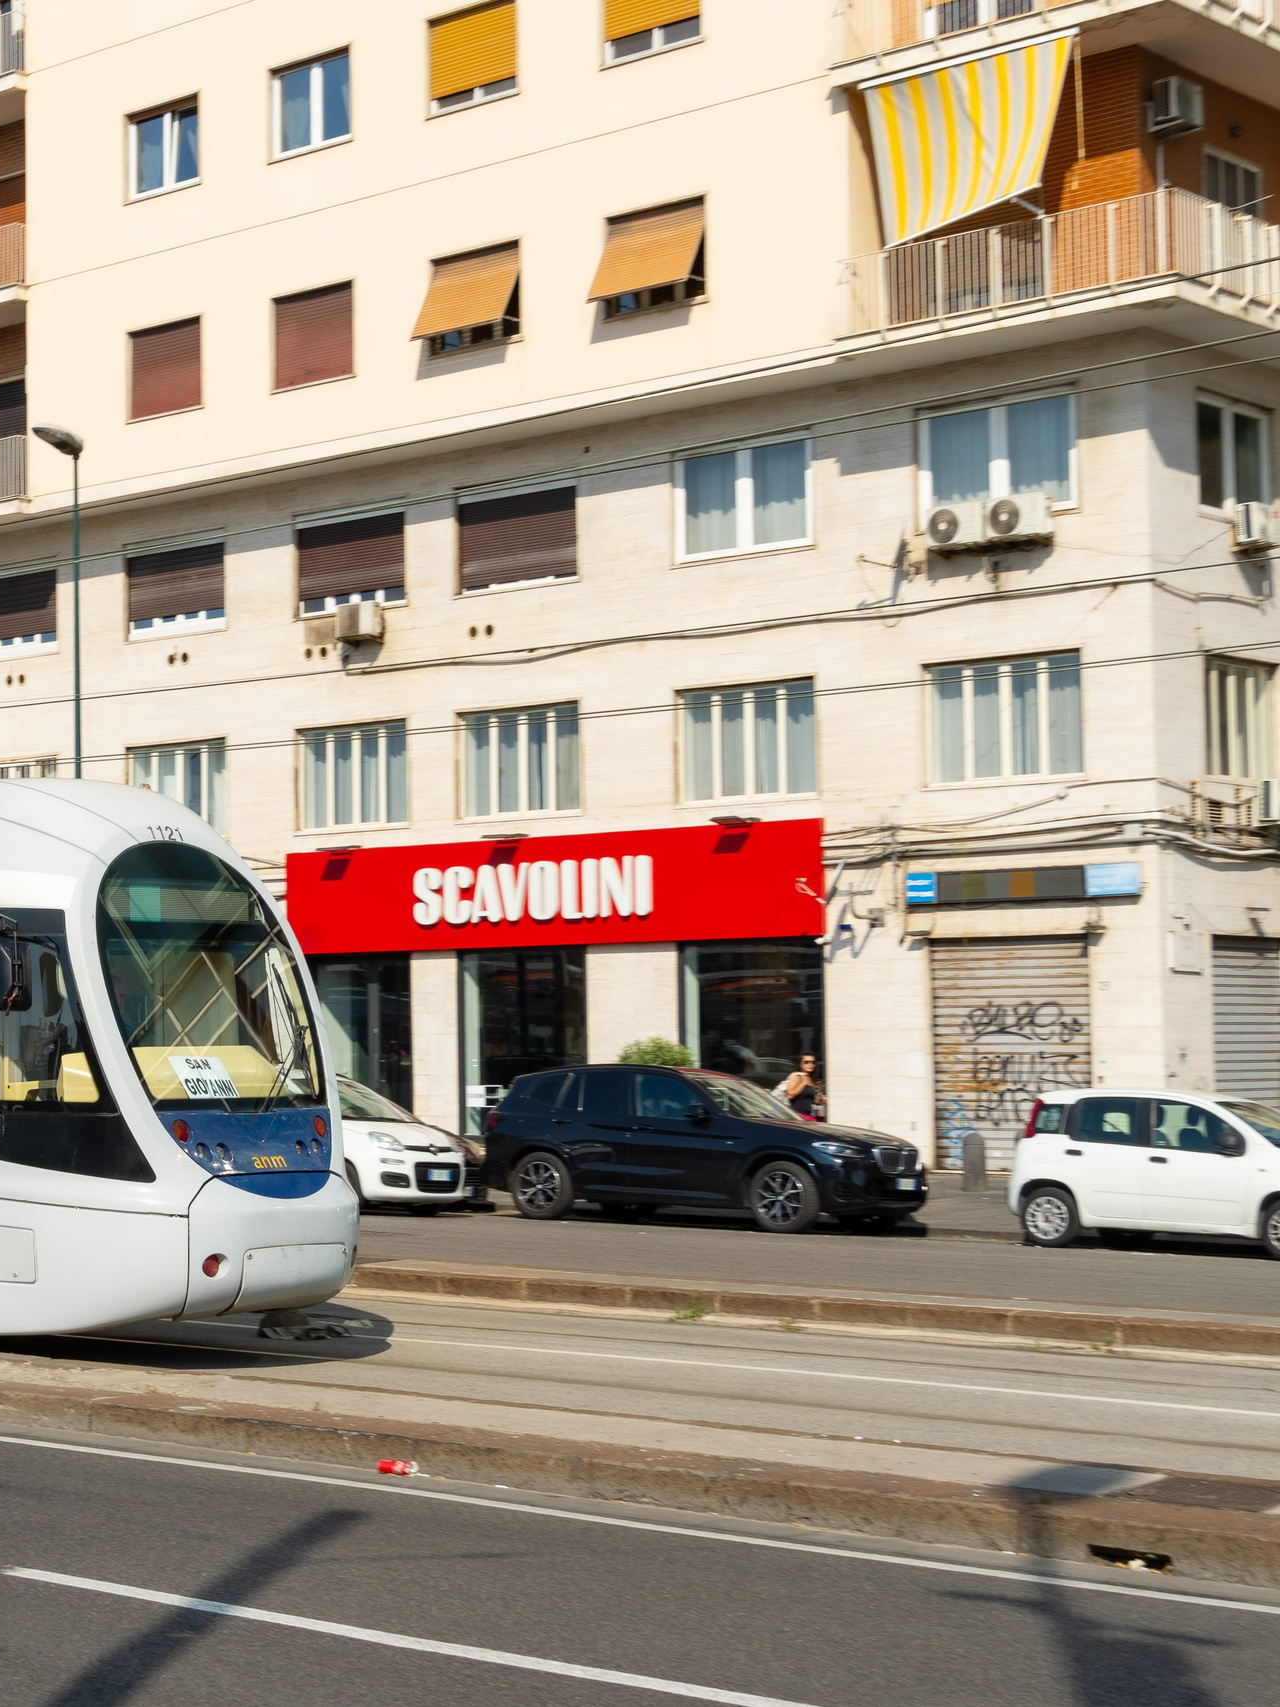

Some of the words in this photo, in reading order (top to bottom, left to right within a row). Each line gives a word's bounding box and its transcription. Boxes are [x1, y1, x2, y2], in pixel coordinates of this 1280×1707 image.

[146, 825, 184, 841] 1121
[412, 855, 654, 926] SCAVOLINI
[185, 1058, 212, 1071] SAN
[184, 1078, 239, 1098] GIOVANNI
[251, 1155, 288, 1169] anm
